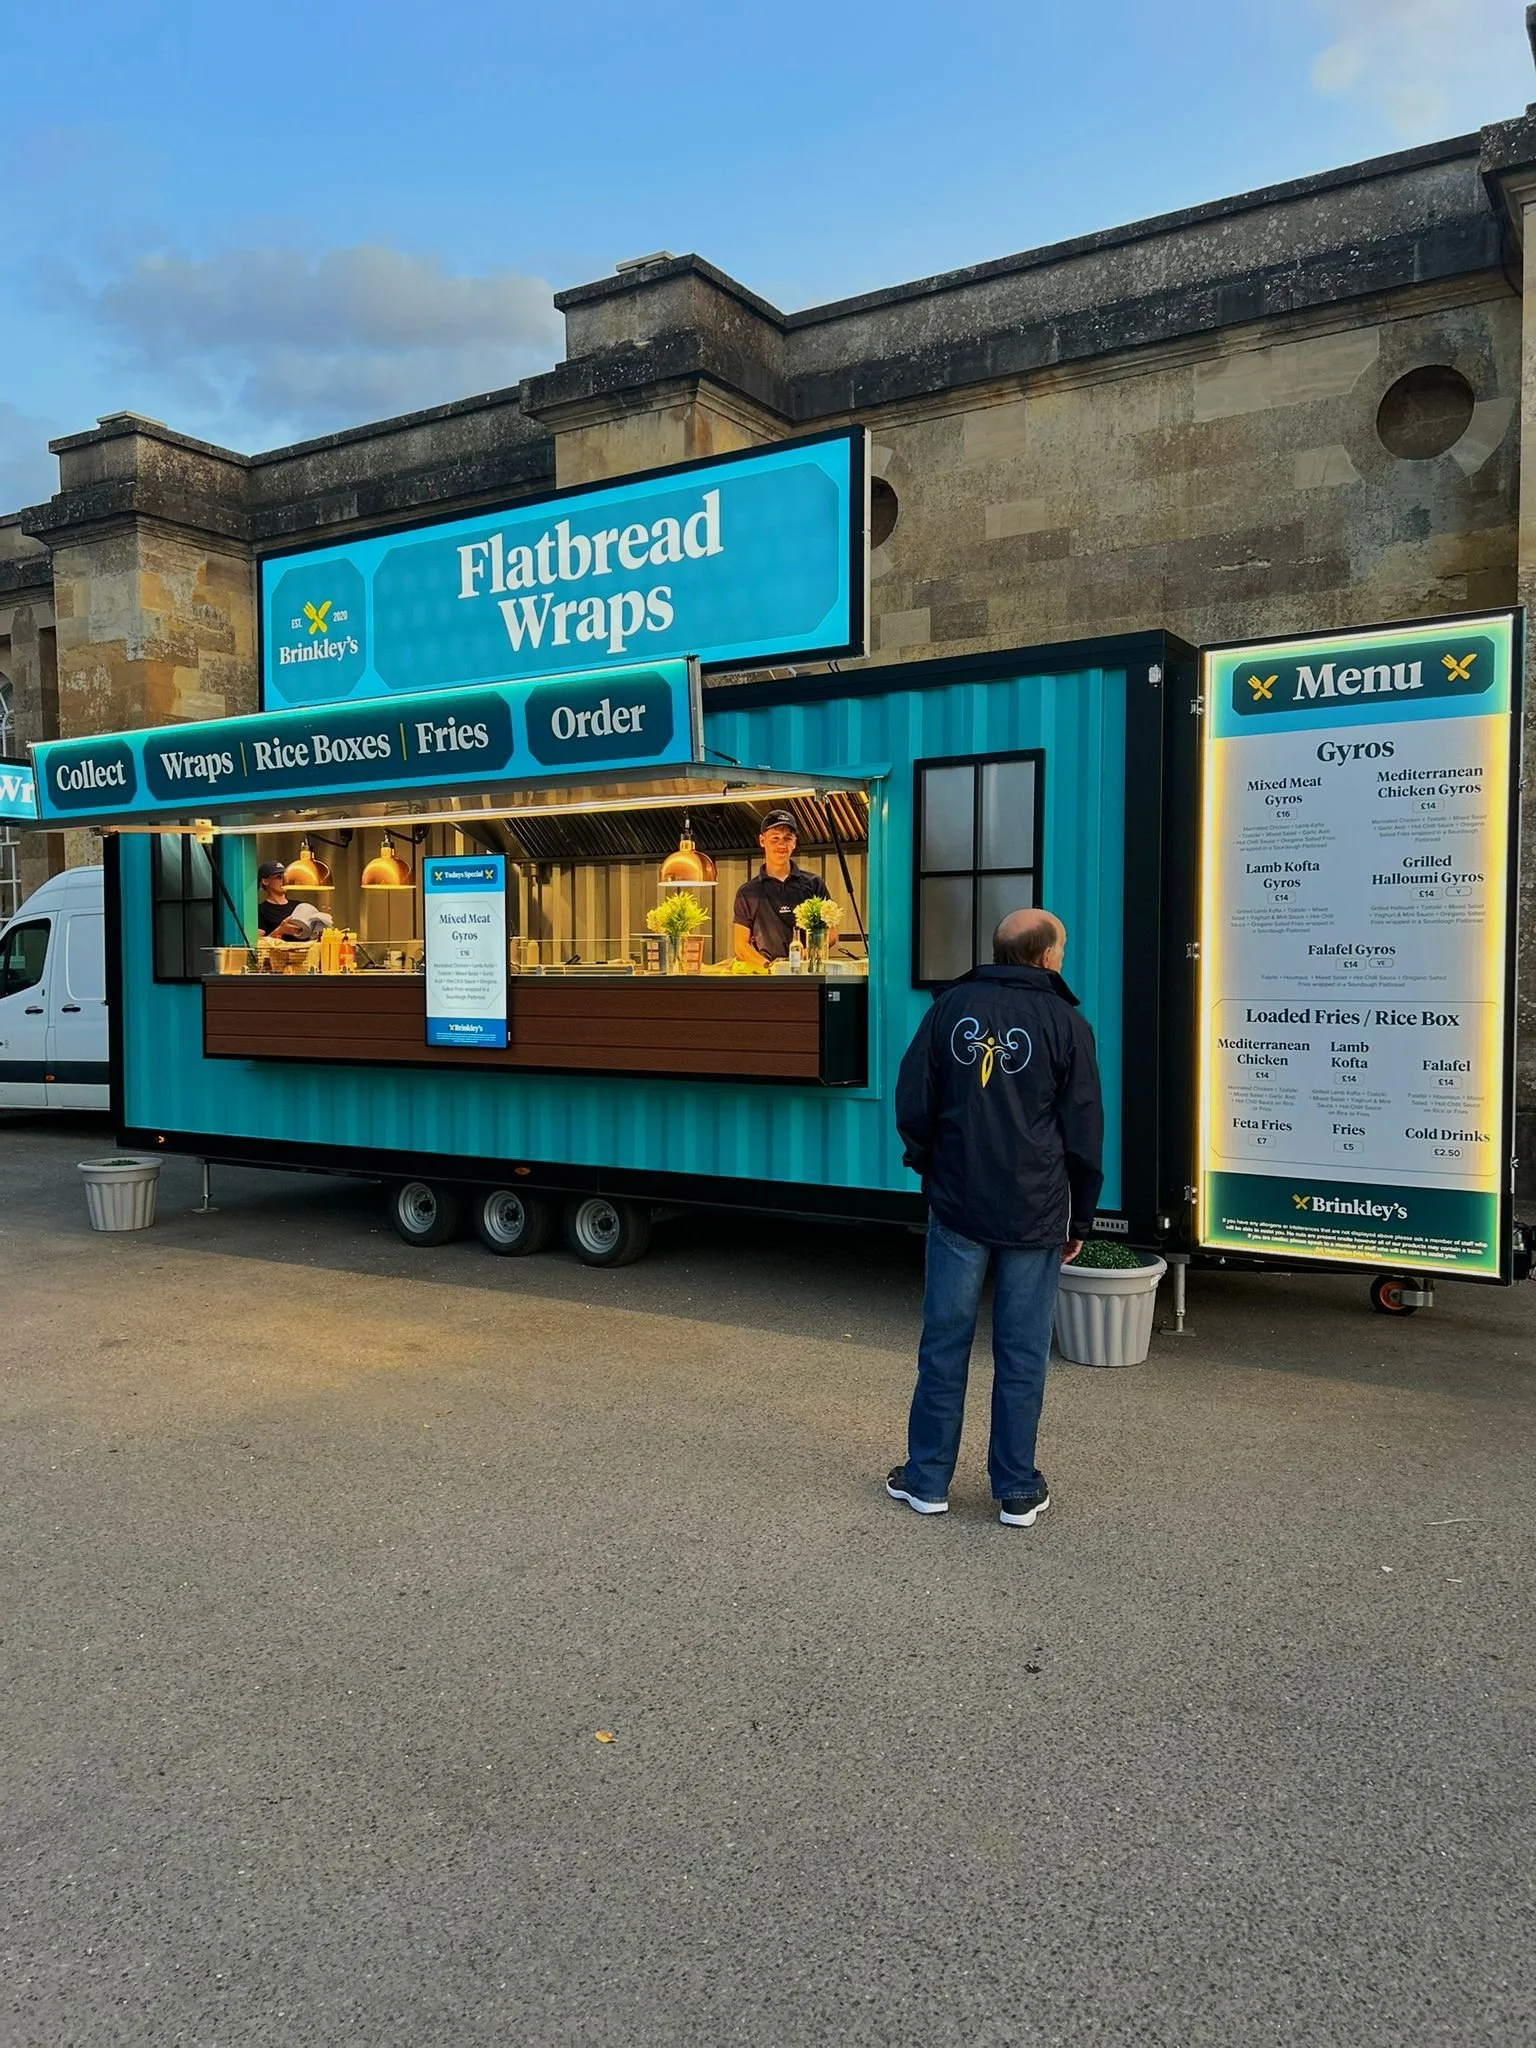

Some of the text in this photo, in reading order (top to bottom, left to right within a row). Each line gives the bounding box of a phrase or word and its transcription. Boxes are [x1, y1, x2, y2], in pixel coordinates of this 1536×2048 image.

[457, 489, 723, 599] Flatbread
[332, 610, 348, 623] 2020
[497, 586, 674, 654] Wraps
[278, 635, 358, 665] Brinkley's
[1292, 659, 1424, 701] Menu
[551, 699, 645, 741] Order
[159, 721, 489, 784] Wraps Rice Boxes Fries
[1316, 740, 1395, 766] Gyros
[55, 757, 125, 791] Collect
[1376, 765, 1484, 783] Mediterranean
[1247, 776, 1322, 791] Mixed Meat
[1377, 783, 1481, 799] Chicken Gyros
[1264, 793, 1303, 807] Gyros
[1420, 801, 1436, 810] £14
[1276, 810, 1291, 819] £16
[1245, 859, 1320, 874] Lamb Kofta
[1402, 855, 1452, 869] Grilled
[464, 870, 483, 879] Special
[1371, 870, 1484, 886] Halloumi Gyros
[1263, 877, 1301, 891] Gyros
[1274, 893, 1288, 902] £14
[1418, 889, 1434, 898] £14
[439, 913, 491, 924] Mixed Meat
[451, 930, 478, 943] Gyros
[1308, 943, 1396, 958] Falafel Gyros
[1343, 960, 1358, 968] £14
[1246, 1008, 1460, 1028] Loaded Fries / Rice Box
[1217, 1038, 1311, 1052] Mediterranean
[1330, 1041, 1369, 1053] Lamb
[1237, 1053, 1289, 1067] Chicken
[1331, 1056, 1368, 1069] Kofta
[1422, 1059, 1471, 1073] Falafel
[1255, 1070, 1269, 1079] £14
[1341, 1074, 1357, 1083] £14
[1438, 1078, 1454, 1087] £14
[1232, 1117, 1293, 1132] Feta Fries
[1332, 1123, 1366, 1137] Fries
[1257, 1137, 1267, 1145] £7
[1404, 1126, 1490, 1143] Cold Drinks
[1343, 1142, 1354, 1151] £5
[1433, 1148, 1461, 1158] £2.50
[1311, 1195, 1408, 1220] Brinkley's
